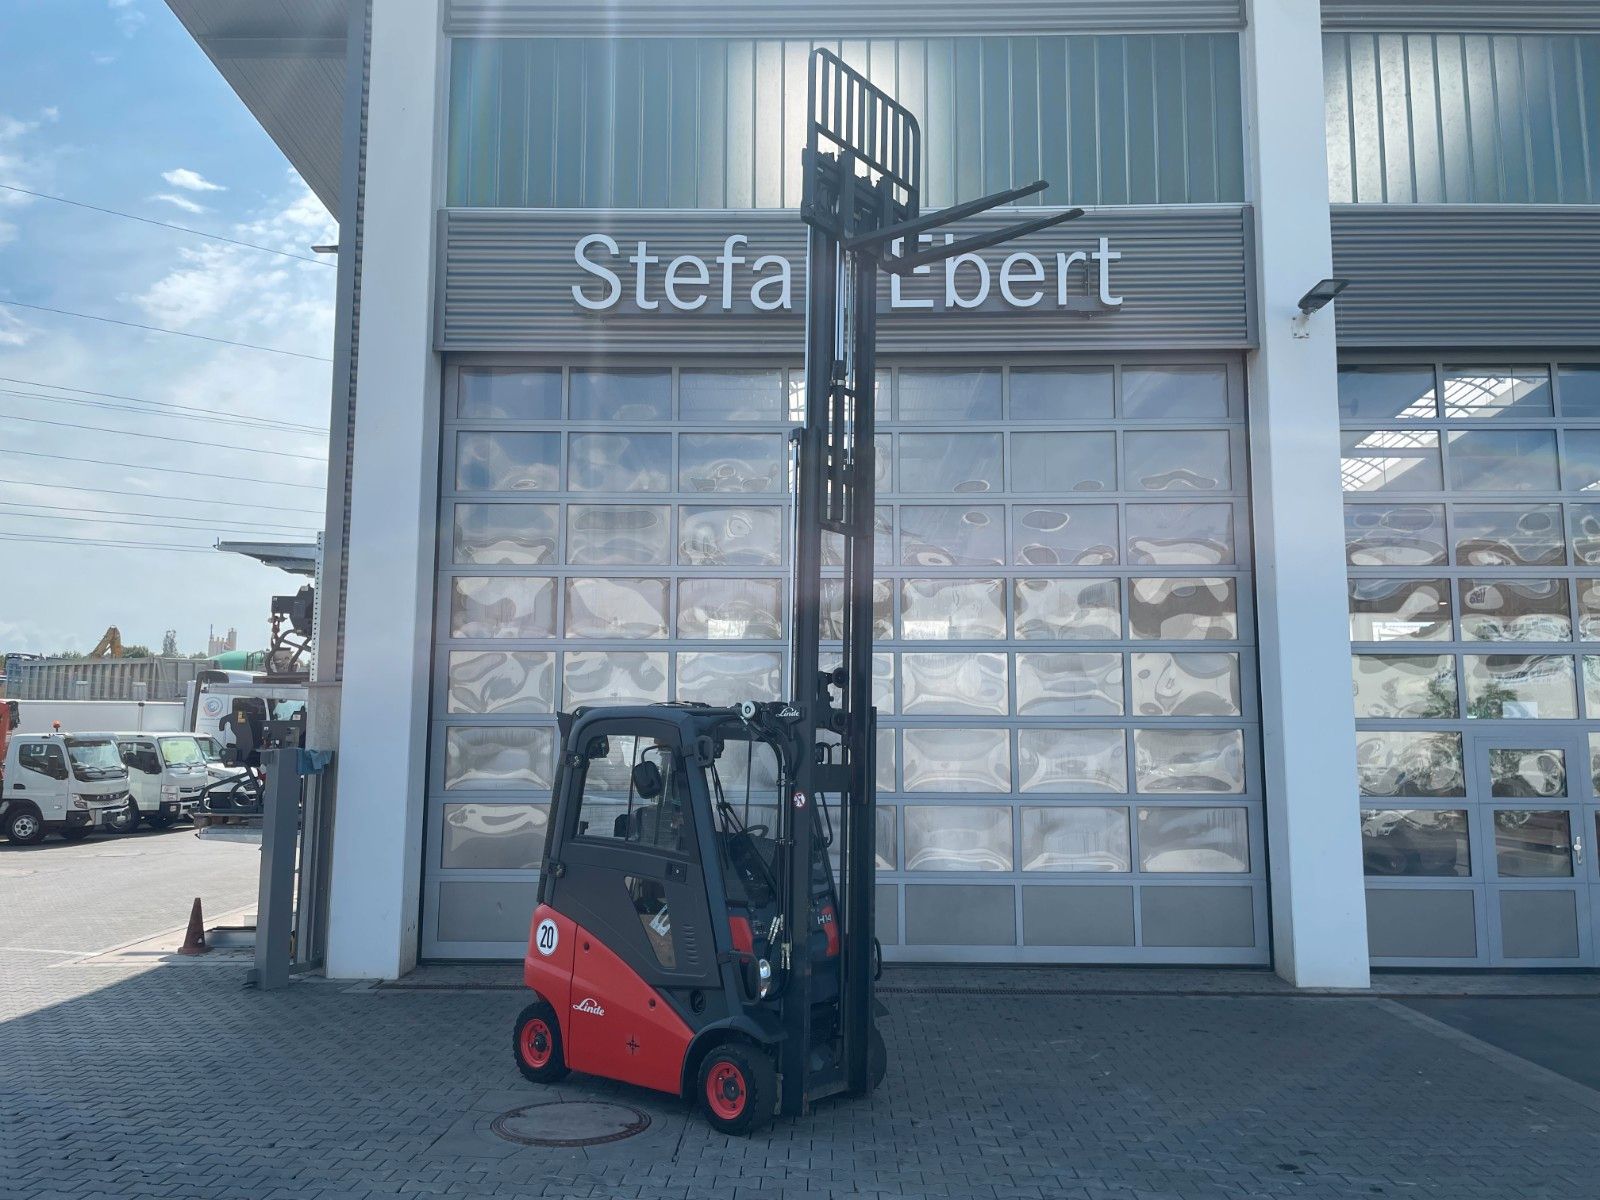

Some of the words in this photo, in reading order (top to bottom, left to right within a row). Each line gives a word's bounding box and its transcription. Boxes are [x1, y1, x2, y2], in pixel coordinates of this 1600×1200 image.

[571, 233, 793, 310] Stefa
[891, 234, 1124, 308] Ebert
[775, 707, 800, 717] Linde
[540, 925, 554, 948] 20
[572, 998, 605, 1016] Linde
